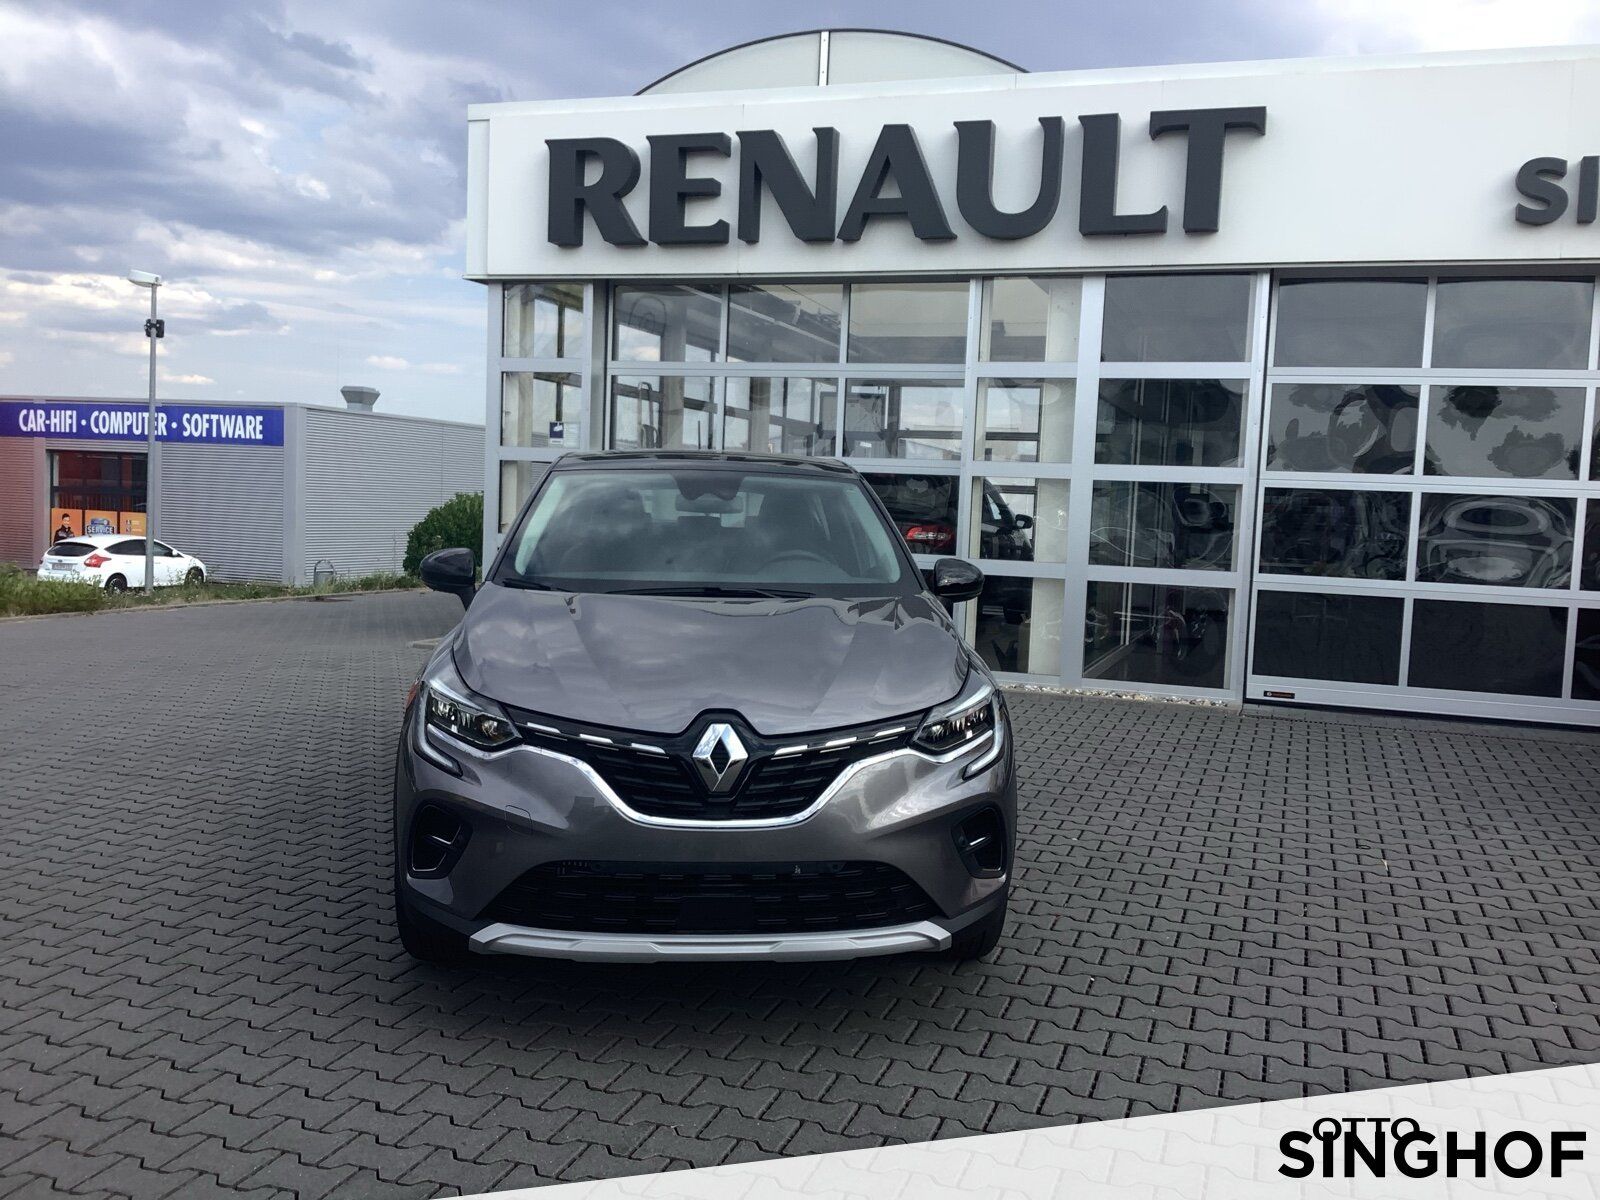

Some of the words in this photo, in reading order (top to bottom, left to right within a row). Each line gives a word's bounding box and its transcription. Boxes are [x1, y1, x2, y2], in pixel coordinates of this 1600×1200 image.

[545, 106, 1267, 247] RENAULT
[19, 409, 77, 433] CAR-HIFI
[182, 413, 263, 439] SOFTWARE
